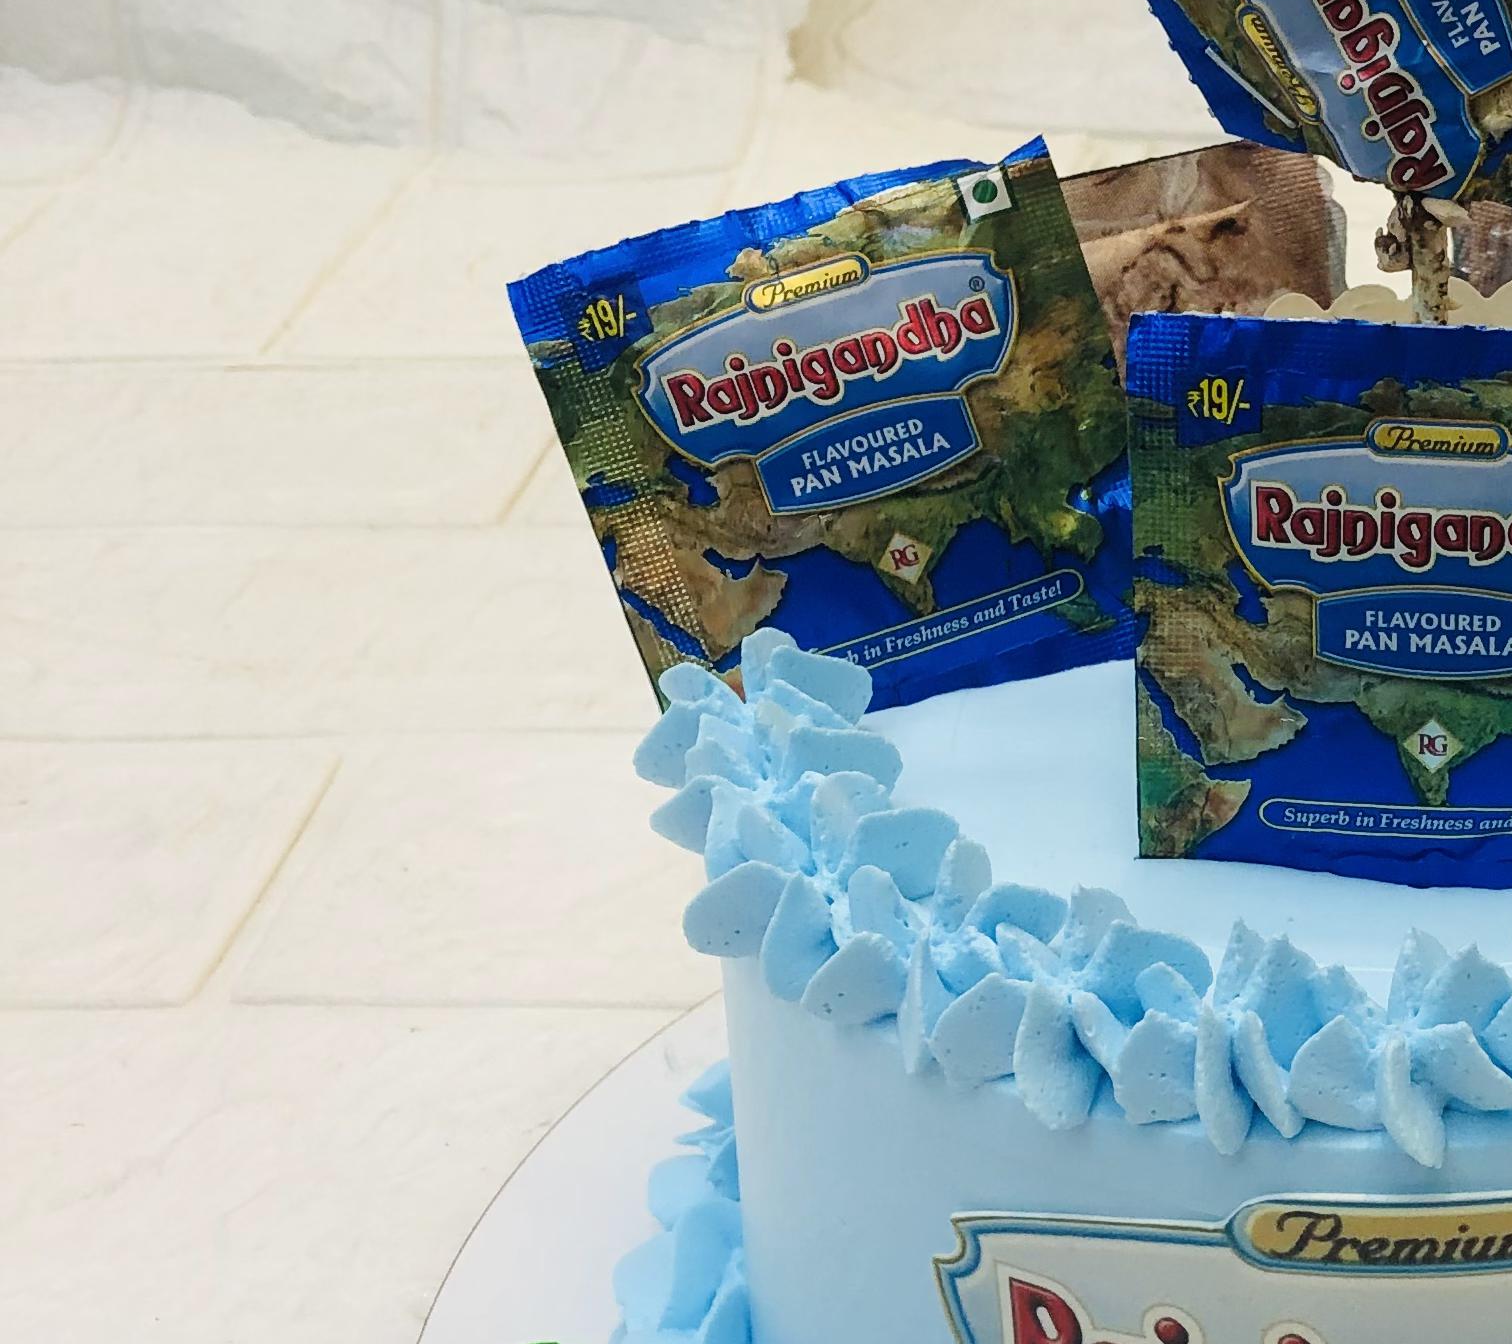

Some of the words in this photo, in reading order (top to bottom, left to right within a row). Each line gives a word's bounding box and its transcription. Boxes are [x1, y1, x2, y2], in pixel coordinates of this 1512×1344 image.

[1460, 1, 1501, 56] PAN
[761, 269, 861, 307] Premium
[666, 297, 996, 428] Rajnigandha
[801, 418, 924, 470] FLAVOURED
[1384, 425, 1498, 454] Premium
[790, 465, 843, 497] PAN
[846, 432, 951, 479] MASALA
[864, 644, 882, 662] in
[884, 615, 969, 654] Freshness
[973, 601, 1006, 624] and
[1007, 580, 1063, 612] Taste!
[1344, 629, 1398, 652] PAN
[1365, 610, 1502, 632] FLAVOURED
[1283, 807, 1350, 826] Superb
[1355, 811, 1375, 827] in
[1380, 813, 1474, 831] Freshness
